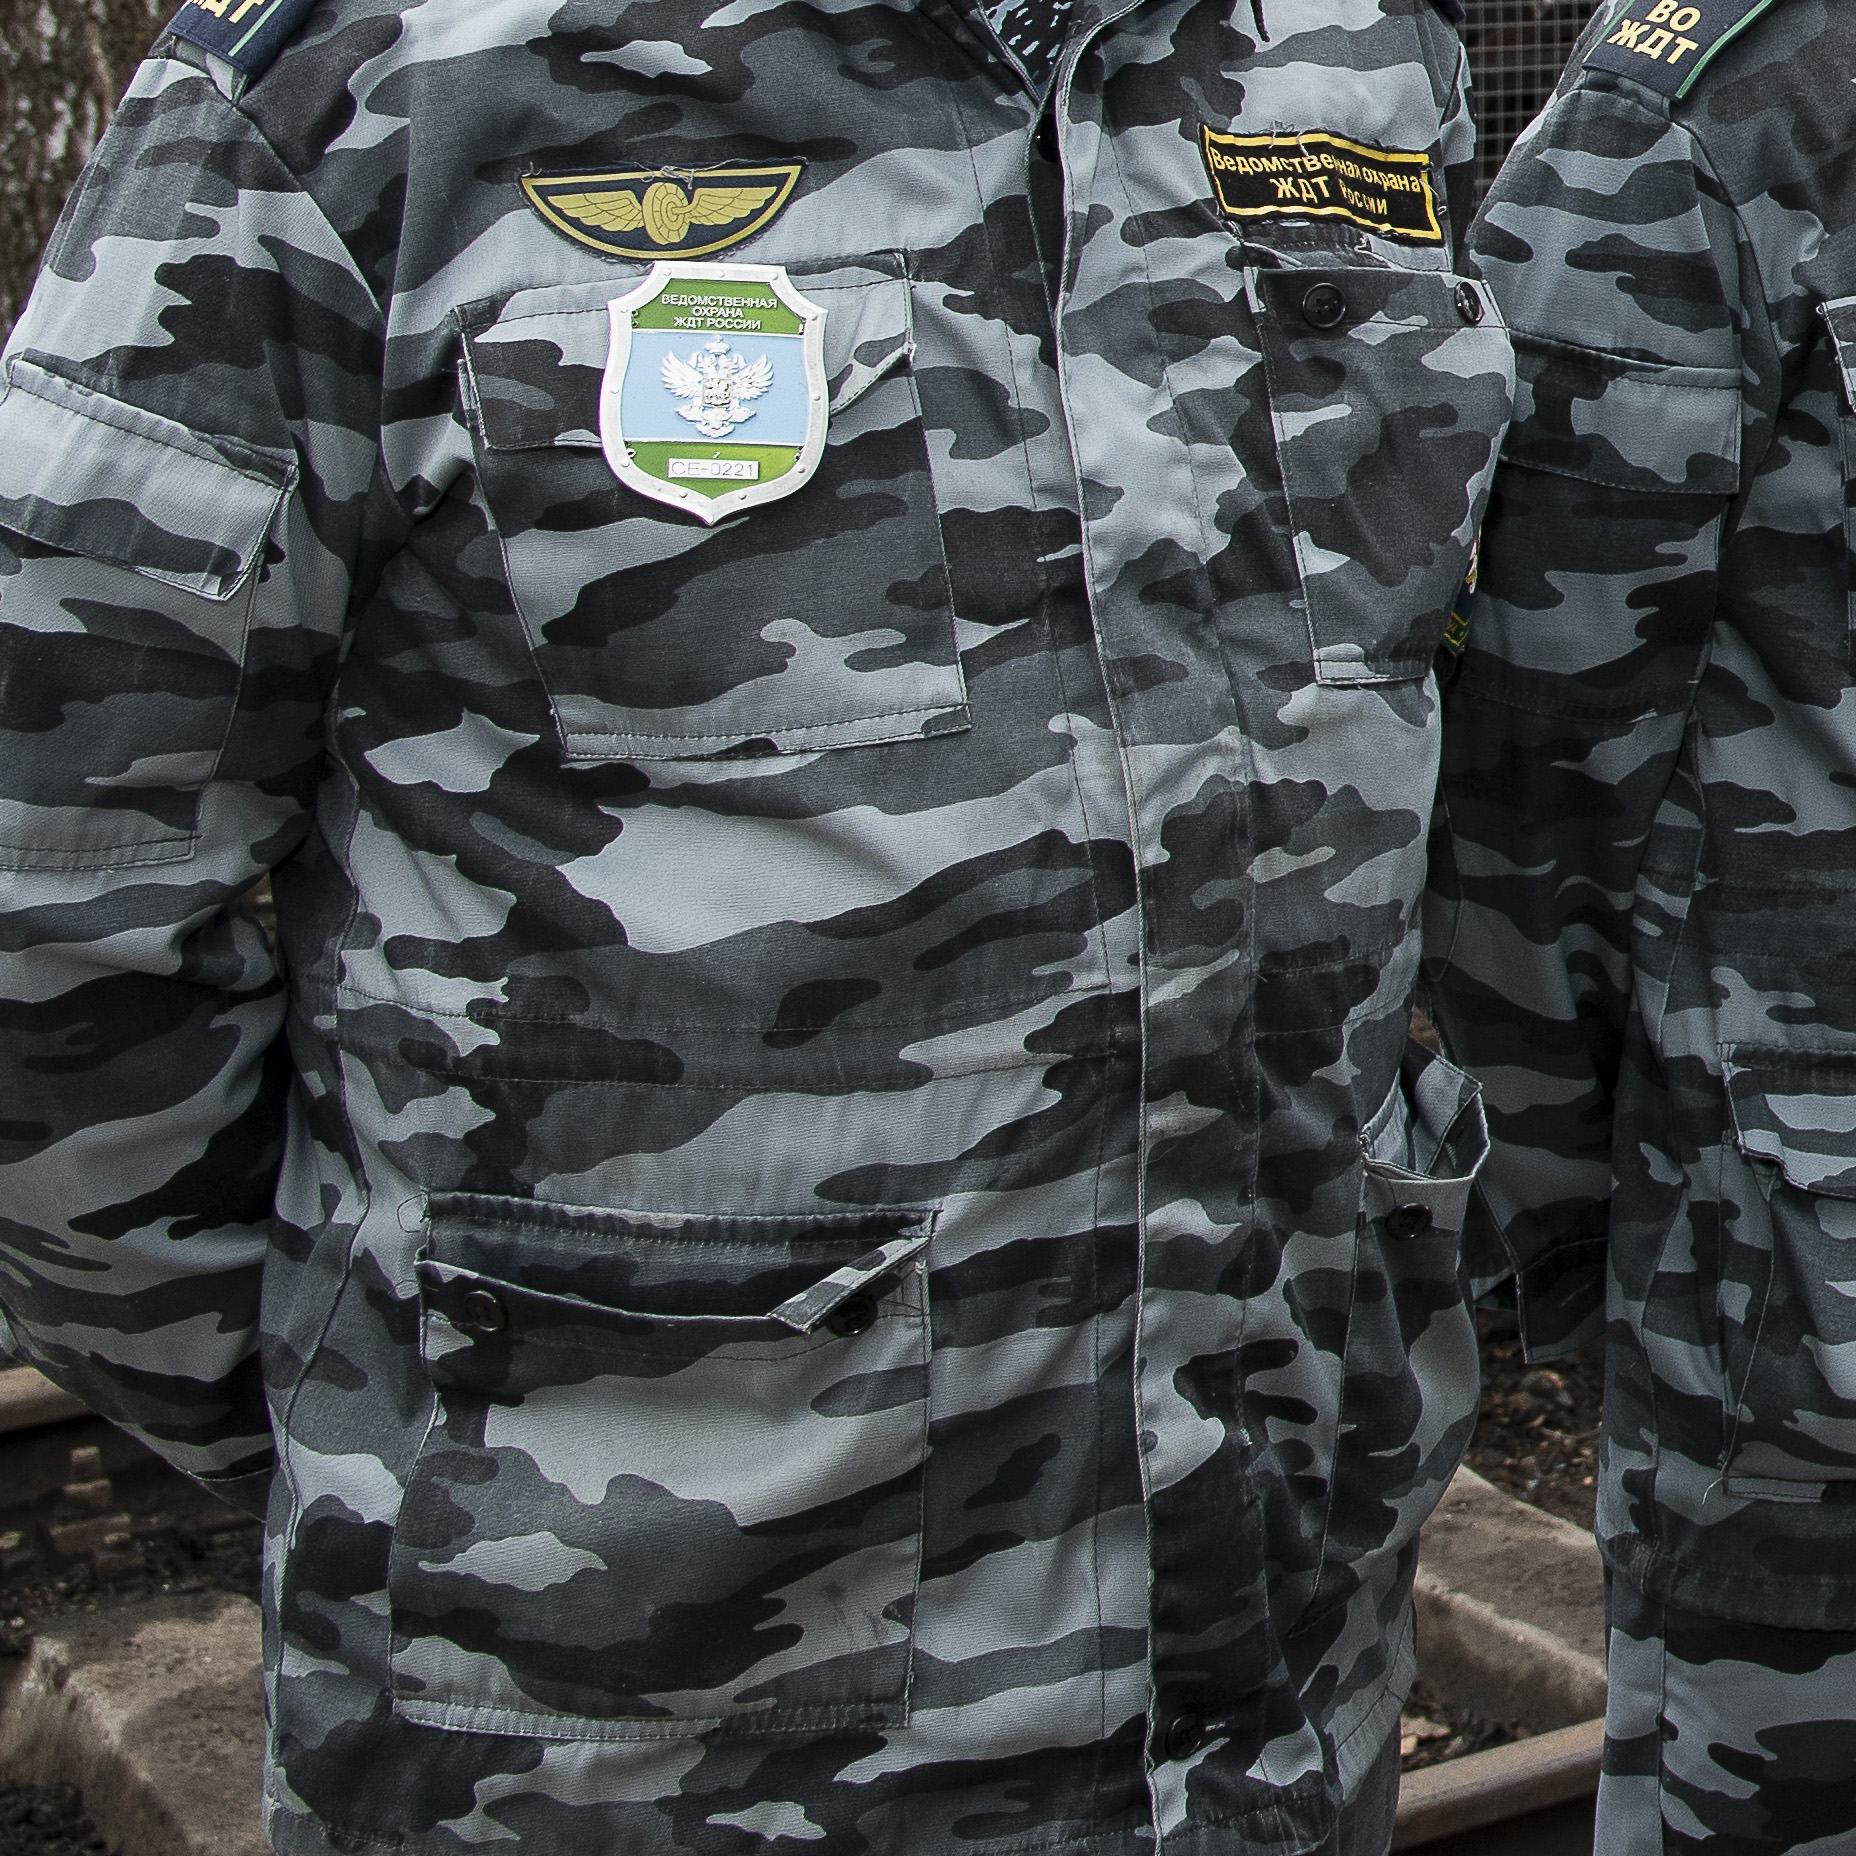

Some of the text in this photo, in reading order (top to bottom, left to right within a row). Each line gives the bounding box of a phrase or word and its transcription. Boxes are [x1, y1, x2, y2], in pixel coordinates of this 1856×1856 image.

[1605, 18, 1700, 65] ЖДТ
[1361, 165, 1422, 194] охрана
[1270, 175, 1388, 216] ЖДТ России
[660, 293, 778, 310] ВЕДОМСТВЕННАЯ
[691, 306, 745, 319] ОХРАНА
[673, 316, 762, 330] ЖДТ РОССИИ
